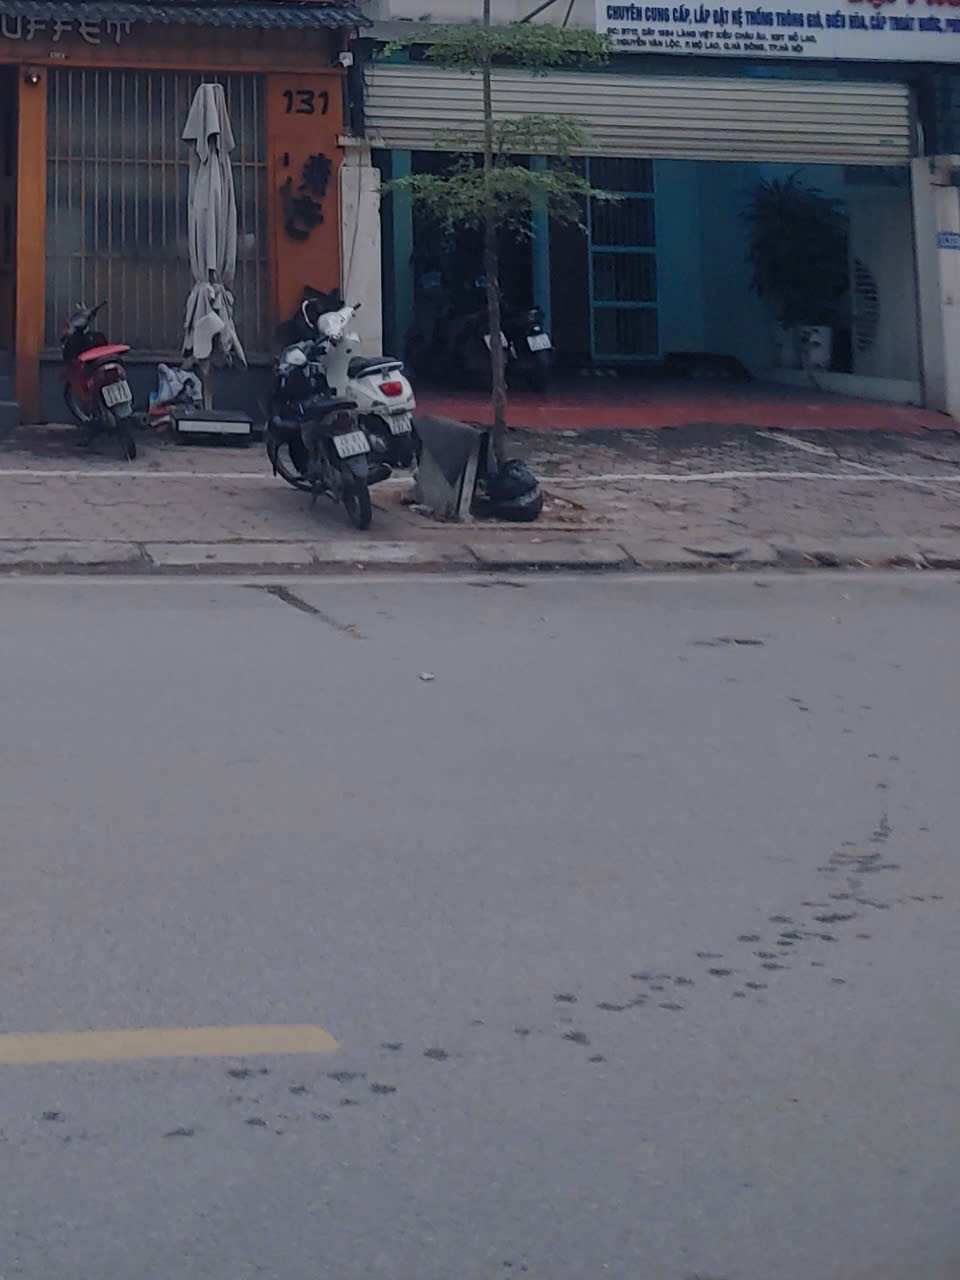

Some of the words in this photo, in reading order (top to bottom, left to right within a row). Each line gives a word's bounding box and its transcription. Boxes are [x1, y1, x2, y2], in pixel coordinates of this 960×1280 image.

[607, 4, 642, 21] CHUYÊN
[645, 7, 670, 22] CUNG
[282, 89, 330, 115] 131
